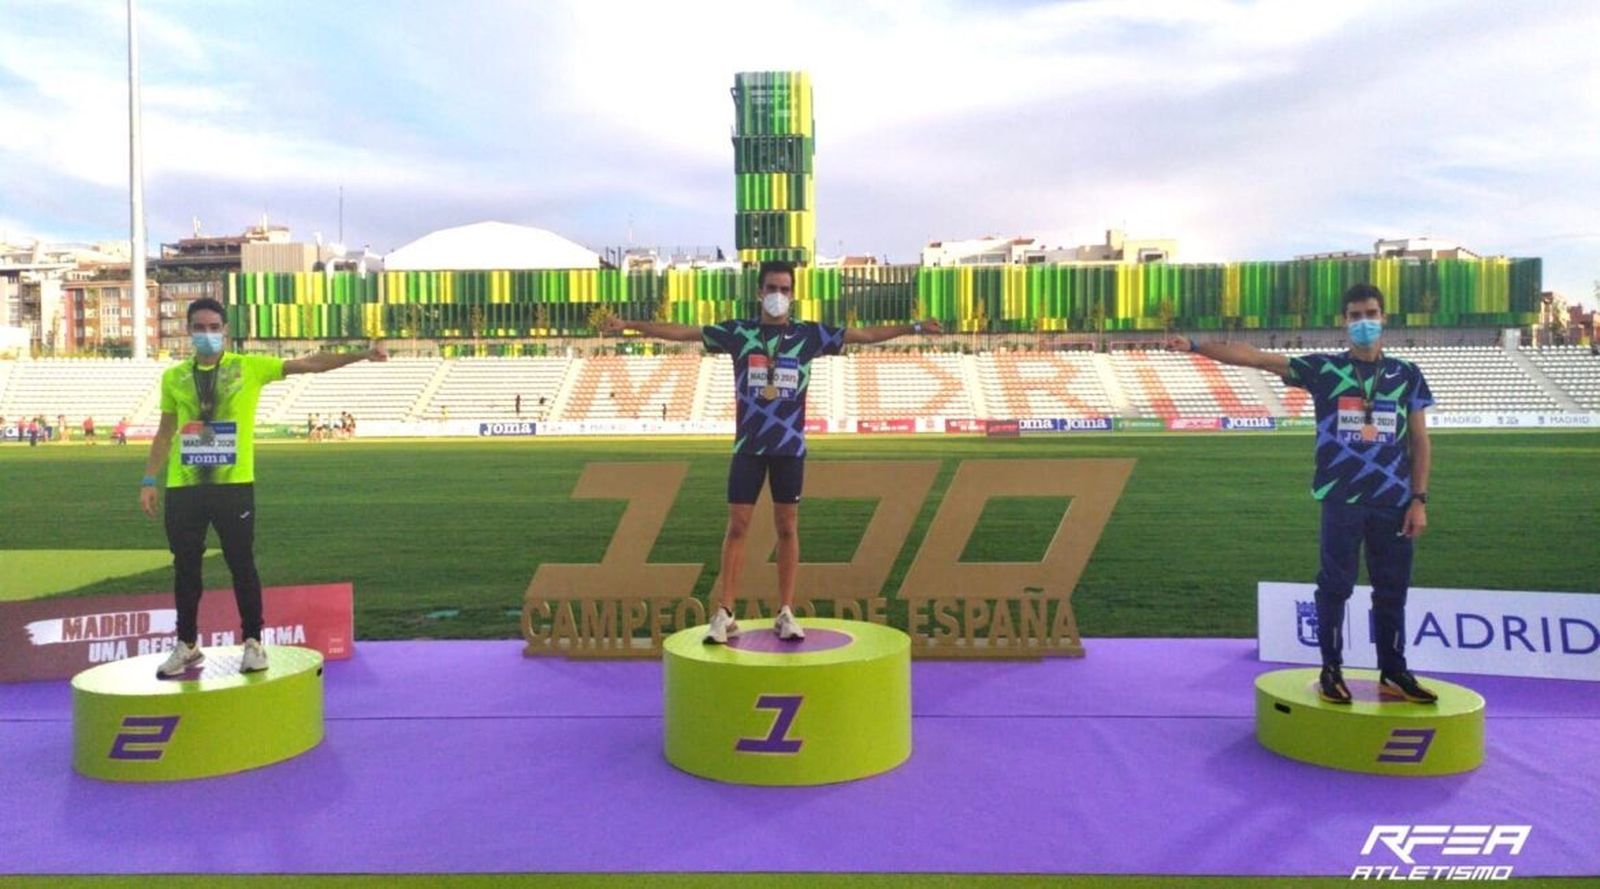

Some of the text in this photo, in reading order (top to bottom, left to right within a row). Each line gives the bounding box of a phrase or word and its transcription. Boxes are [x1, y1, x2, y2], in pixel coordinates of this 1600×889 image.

[522, 458, 1137, 600] 100
[62, 612, 150, 641] MADRID
[909, 586, 1083, 648] ESPAÑA
[1368, 608, 1600, 656] ADRID
[88, 641, 128, 663] UNA
[260, 624, 307, 646] RMA
[107, 715, 182, 761] 2
[735, 693, 804, 754] 1
[1376, 728, 1437, 764] 3
